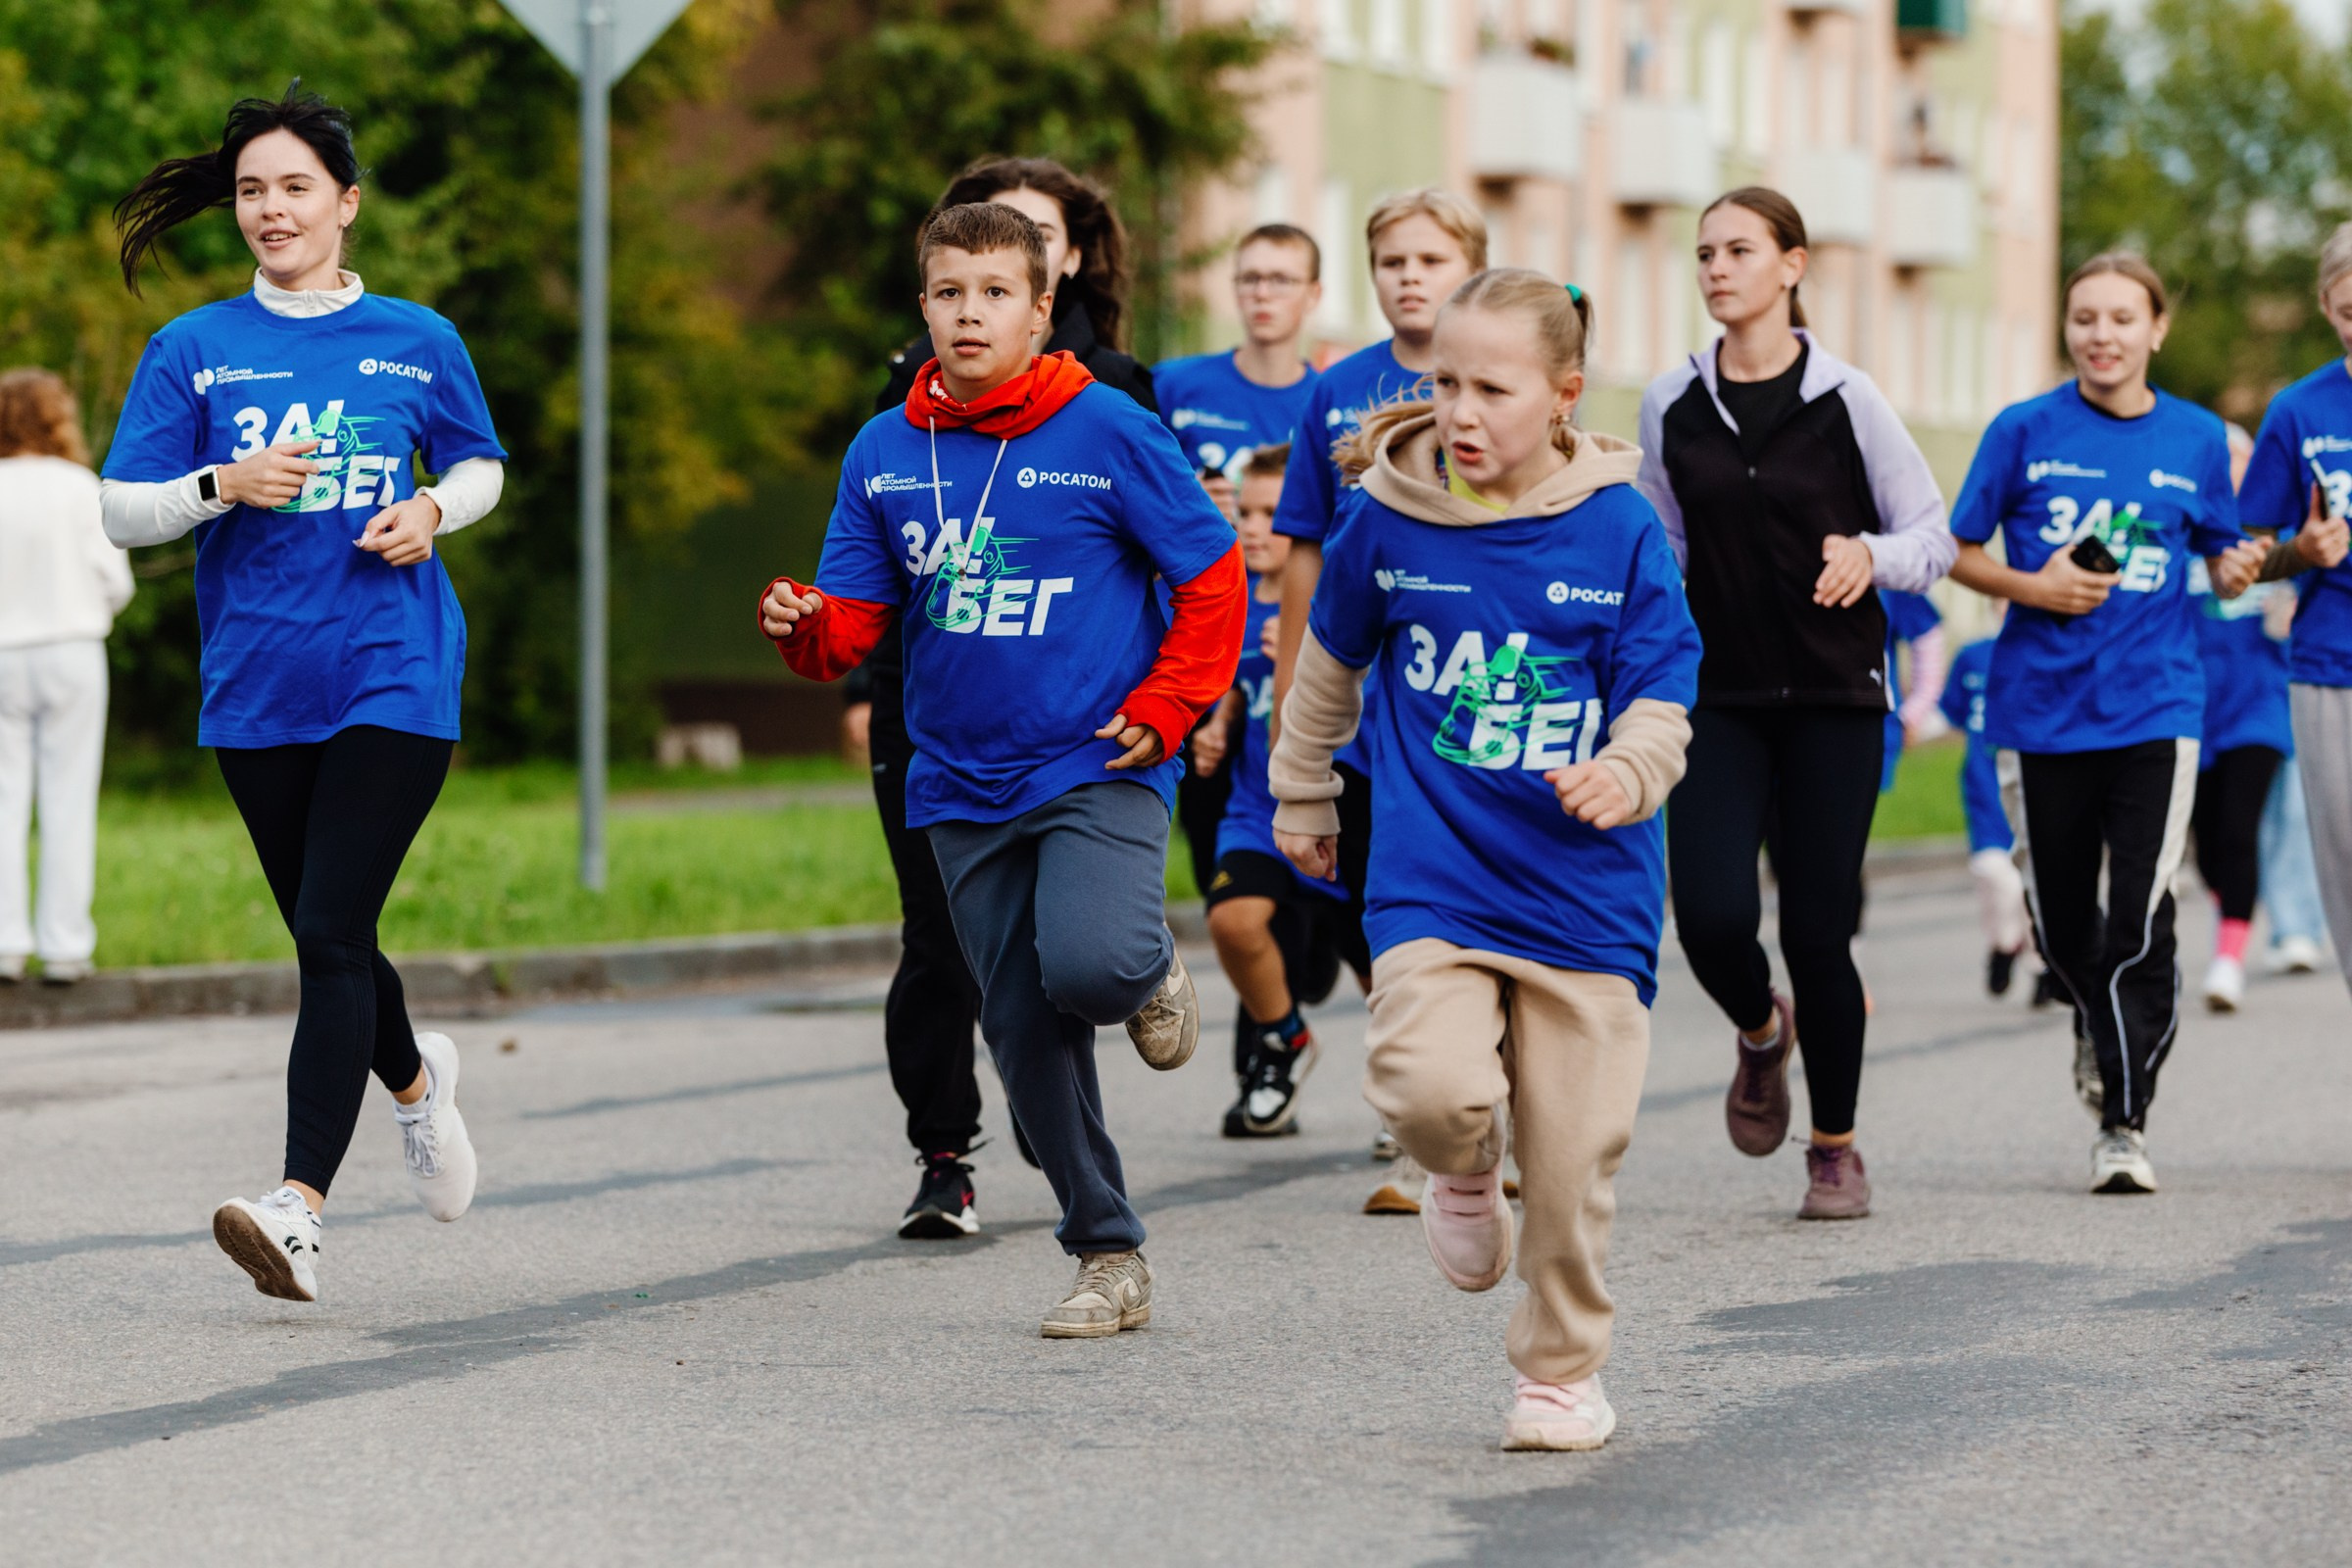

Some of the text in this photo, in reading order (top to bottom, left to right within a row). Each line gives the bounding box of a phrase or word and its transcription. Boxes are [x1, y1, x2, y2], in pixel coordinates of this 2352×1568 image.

[379, 361, 433, 383] РОСАТОМ
[881, 476, 916, 485] АТОМНОЙ
[1039, 471, 1112, 490] РОСАТОМ
[1570, 587, 1624, 606] РОСАТ
[945, 577, 1074, 636] БЕГ
